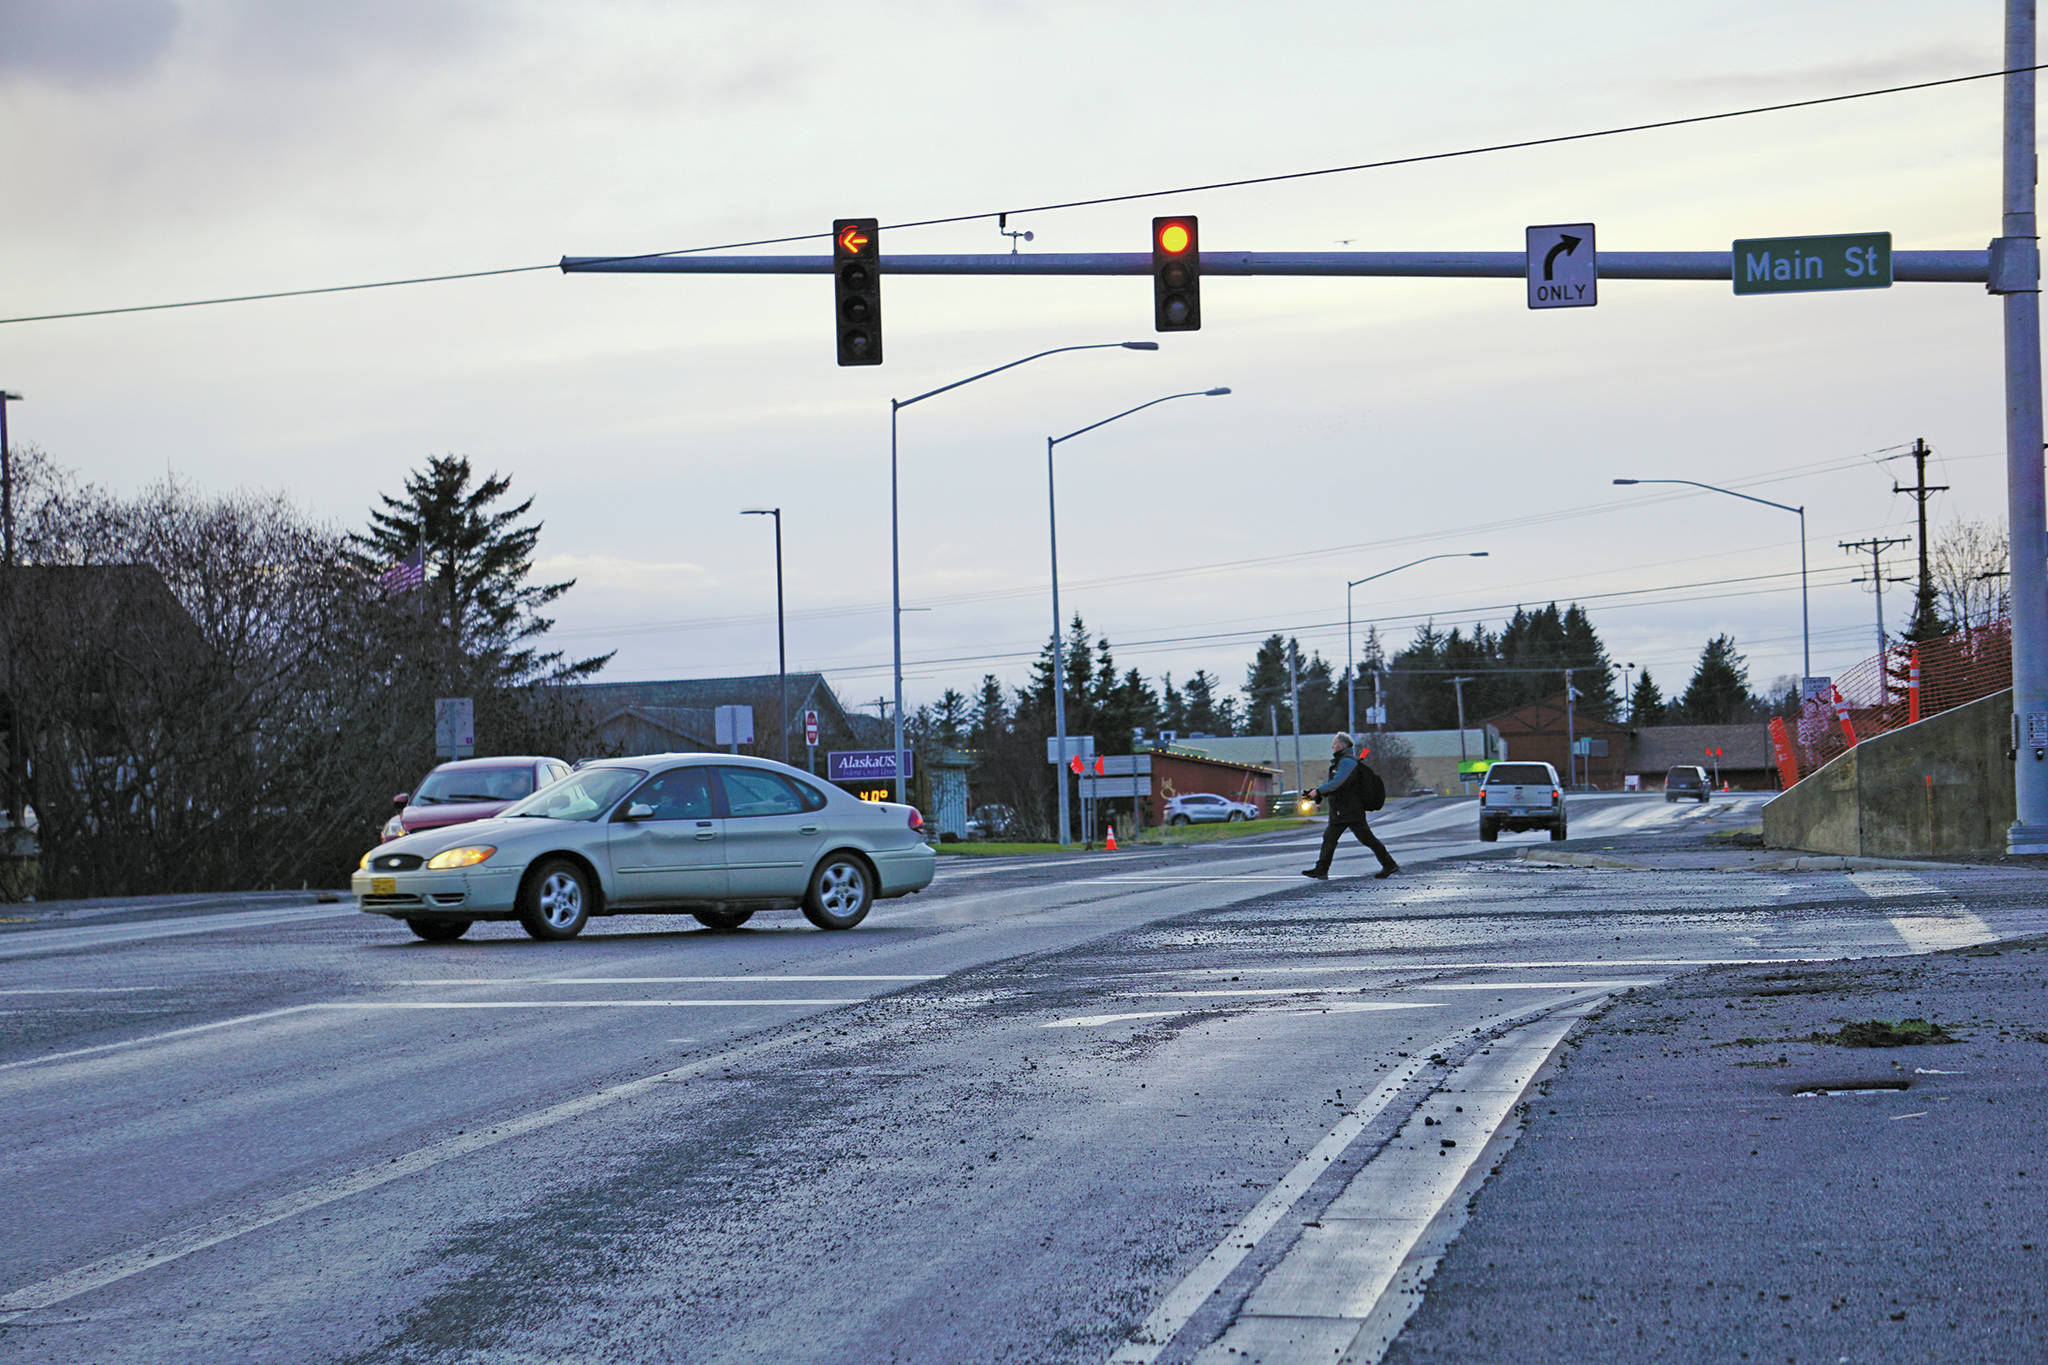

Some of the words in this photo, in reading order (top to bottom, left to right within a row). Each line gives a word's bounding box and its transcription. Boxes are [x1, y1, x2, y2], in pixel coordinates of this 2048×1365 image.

[1746, 250, 1823, 282] Main
[1844, 245, 1878, 277] St
[1537, 284, 1586, 301] ONLY
